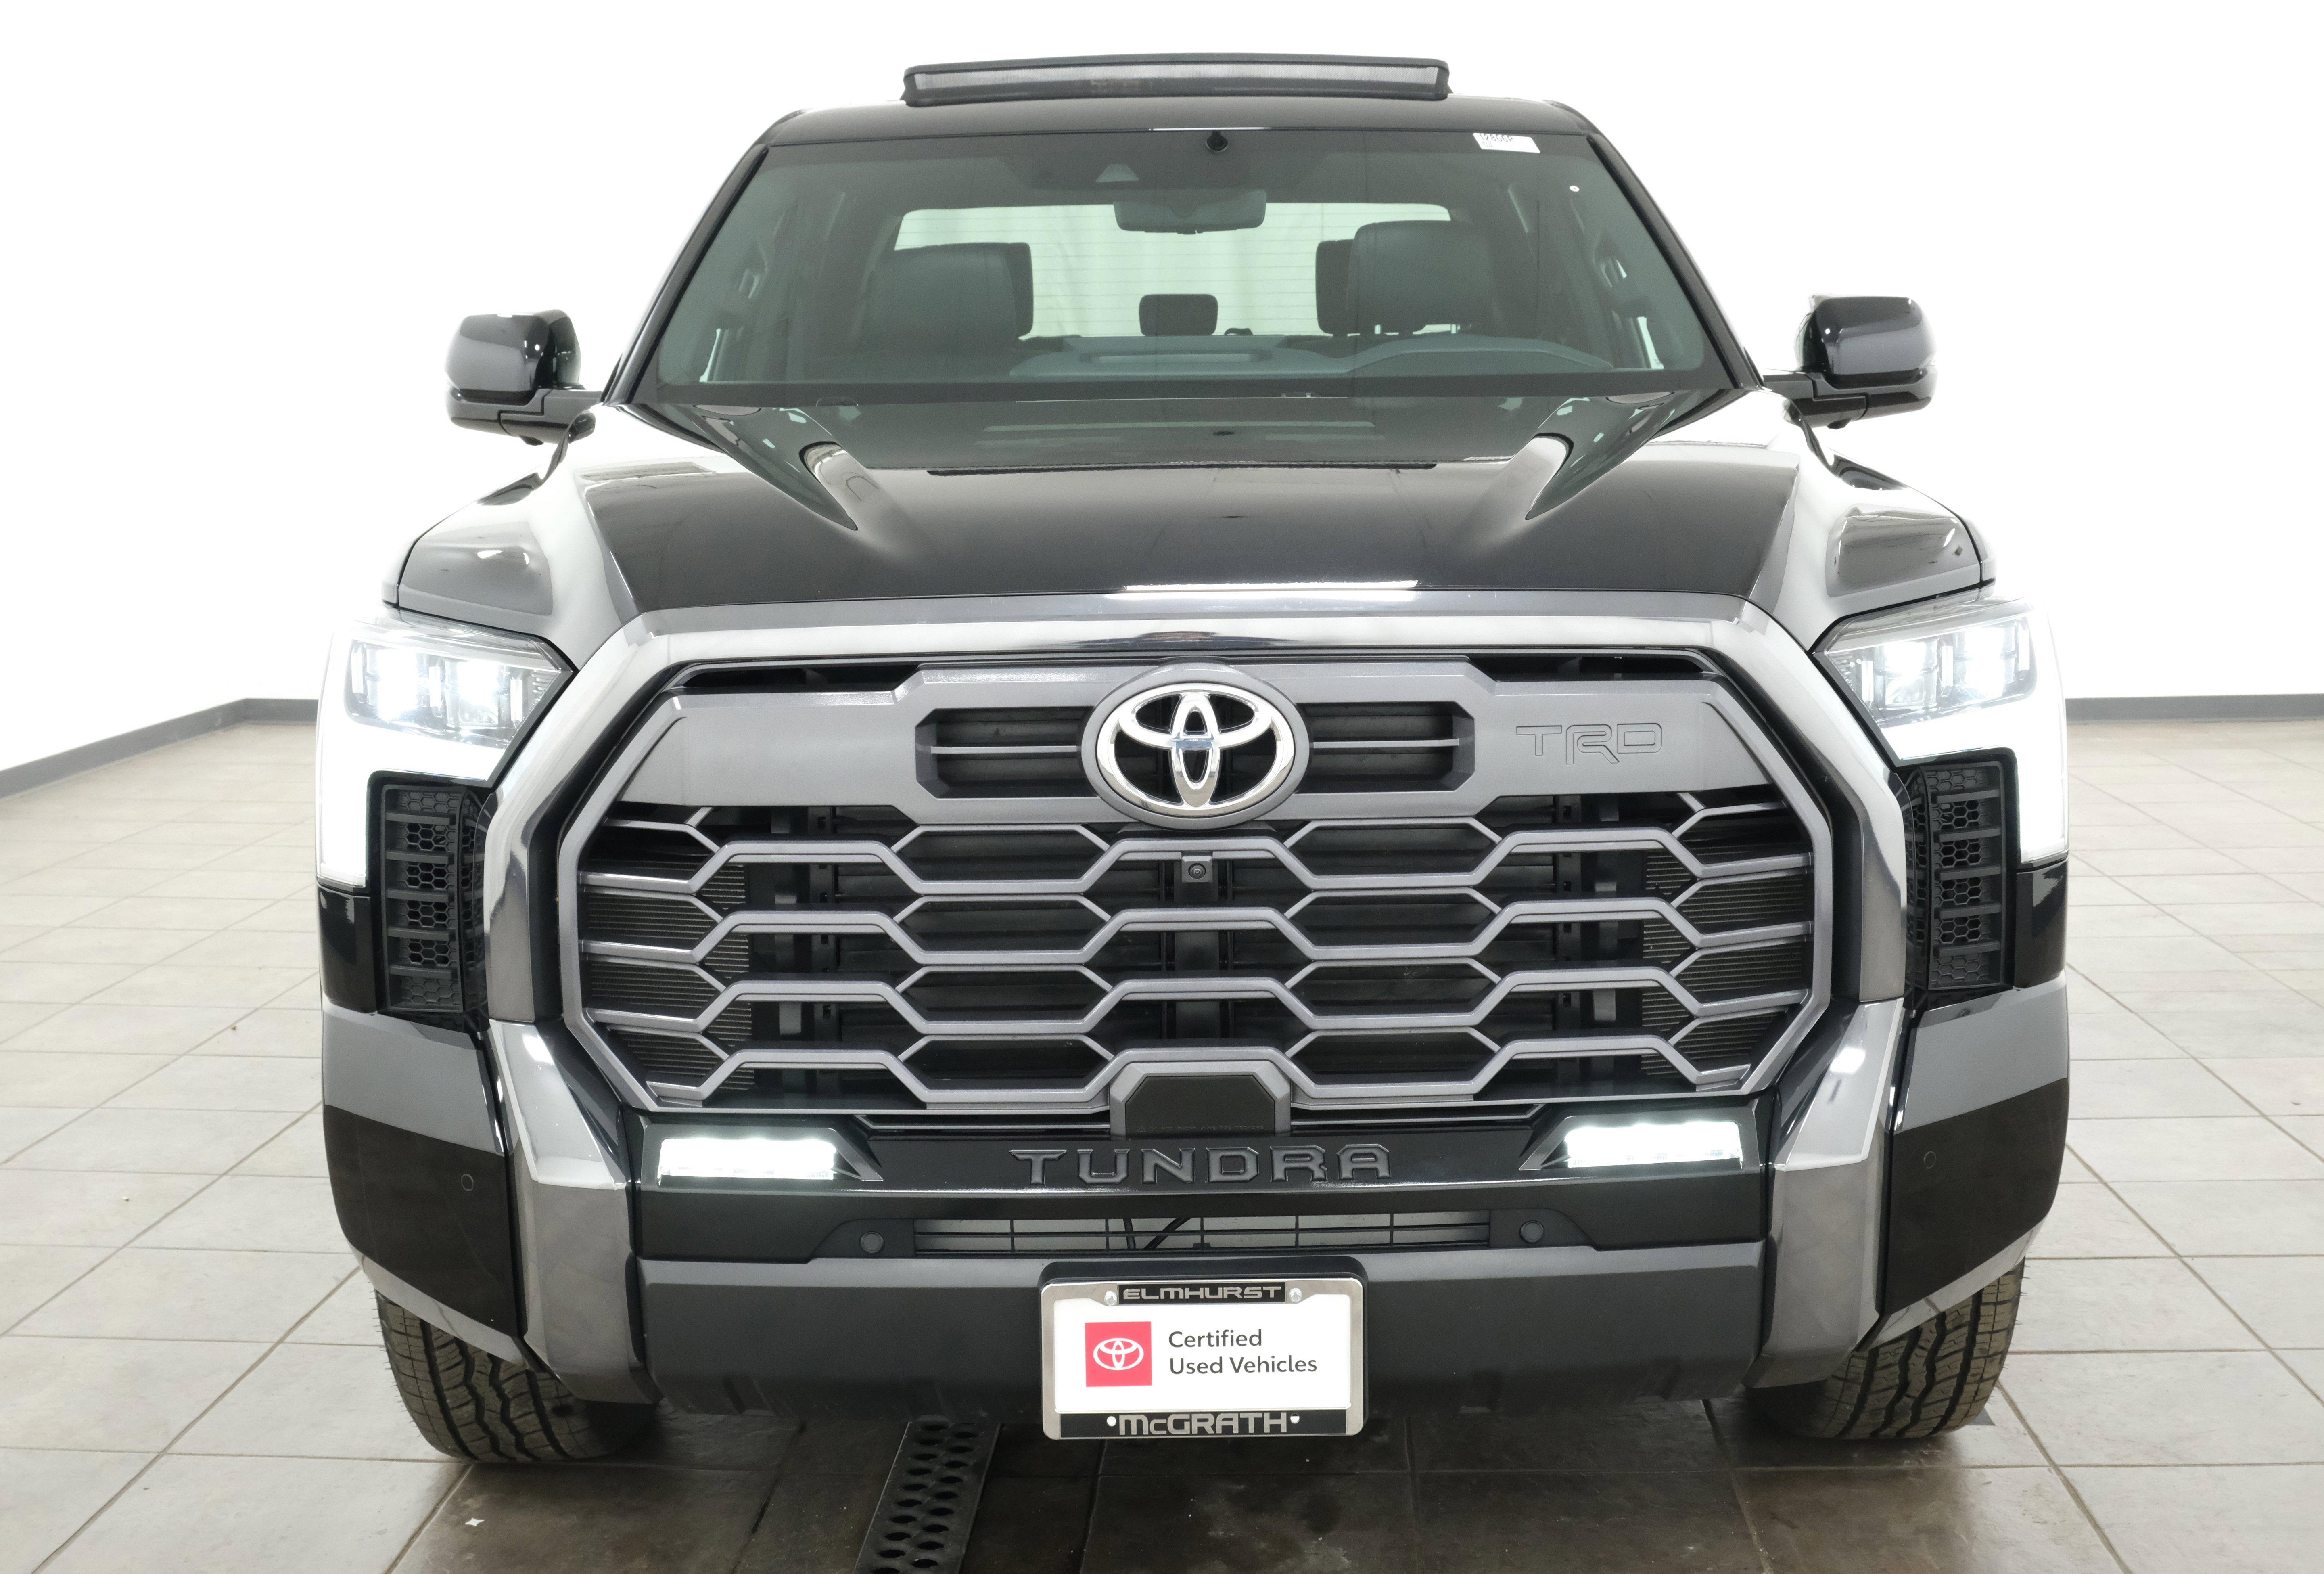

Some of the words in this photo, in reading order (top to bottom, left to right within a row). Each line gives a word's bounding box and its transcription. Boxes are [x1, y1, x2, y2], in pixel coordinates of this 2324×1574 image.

[1516, 723, 1662, 765] TRD
[1009, 1144, 1391, 1185] TUNDRA
[1123, 1286, 1282, 1300] ELMHURST
[1168, 1329, 1262, 1348] Certified
[1169, 1356, 1223, 1375] Used
[1229, 1355, 1317, 1373] Vehicles
[1119, 1413, 1287, 1435] McGRATH
